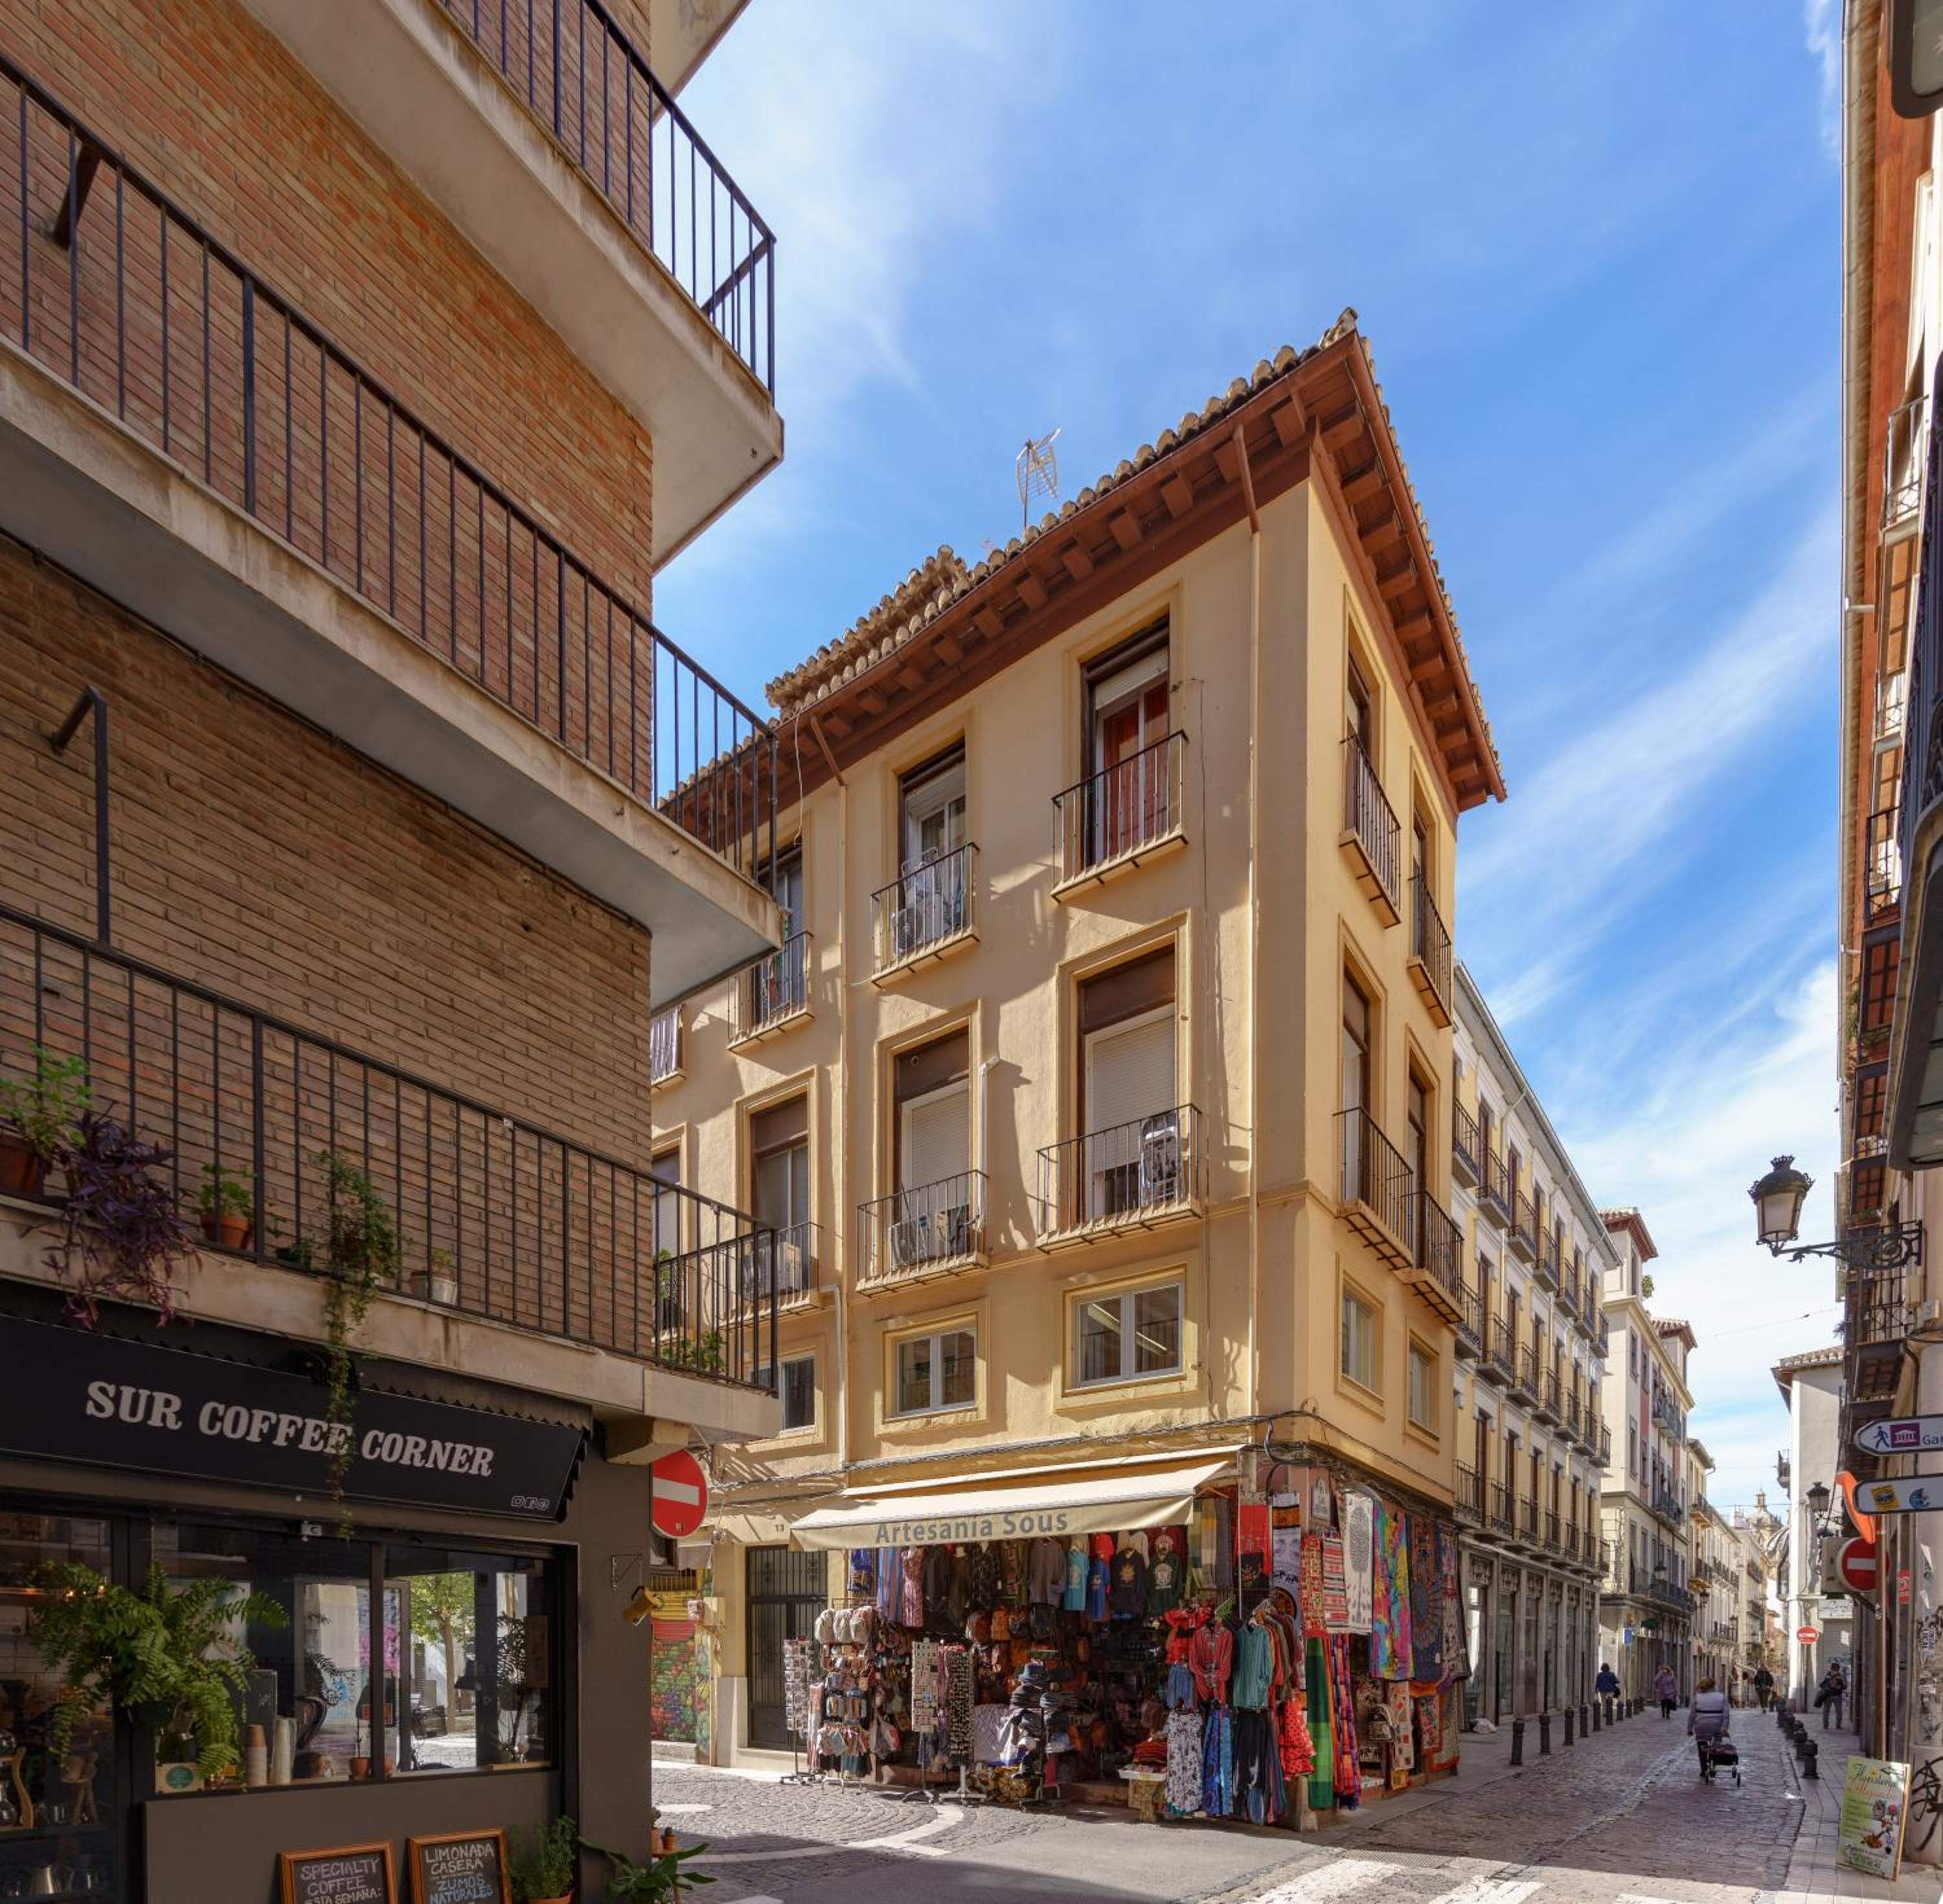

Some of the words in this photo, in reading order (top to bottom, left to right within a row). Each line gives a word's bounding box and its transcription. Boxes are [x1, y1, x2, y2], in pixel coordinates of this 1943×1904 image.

[86, 1381, 182, 1430] SUR
[198, 1401, 354, 1455] COFFEE
[361, 1429, 494, 1477] CORNER
[1003, 1512, 1068, 1535] Sous
[425, 1843, 495, 1863] LIMONADA
[301, 1857, 381, 1880] SPECIALTY
[431, 1858, 483, 1875] CASERA
[307, 1876, 366, 1896] COFFEE
[436, 1873, 485, 1891] ZUMOS
